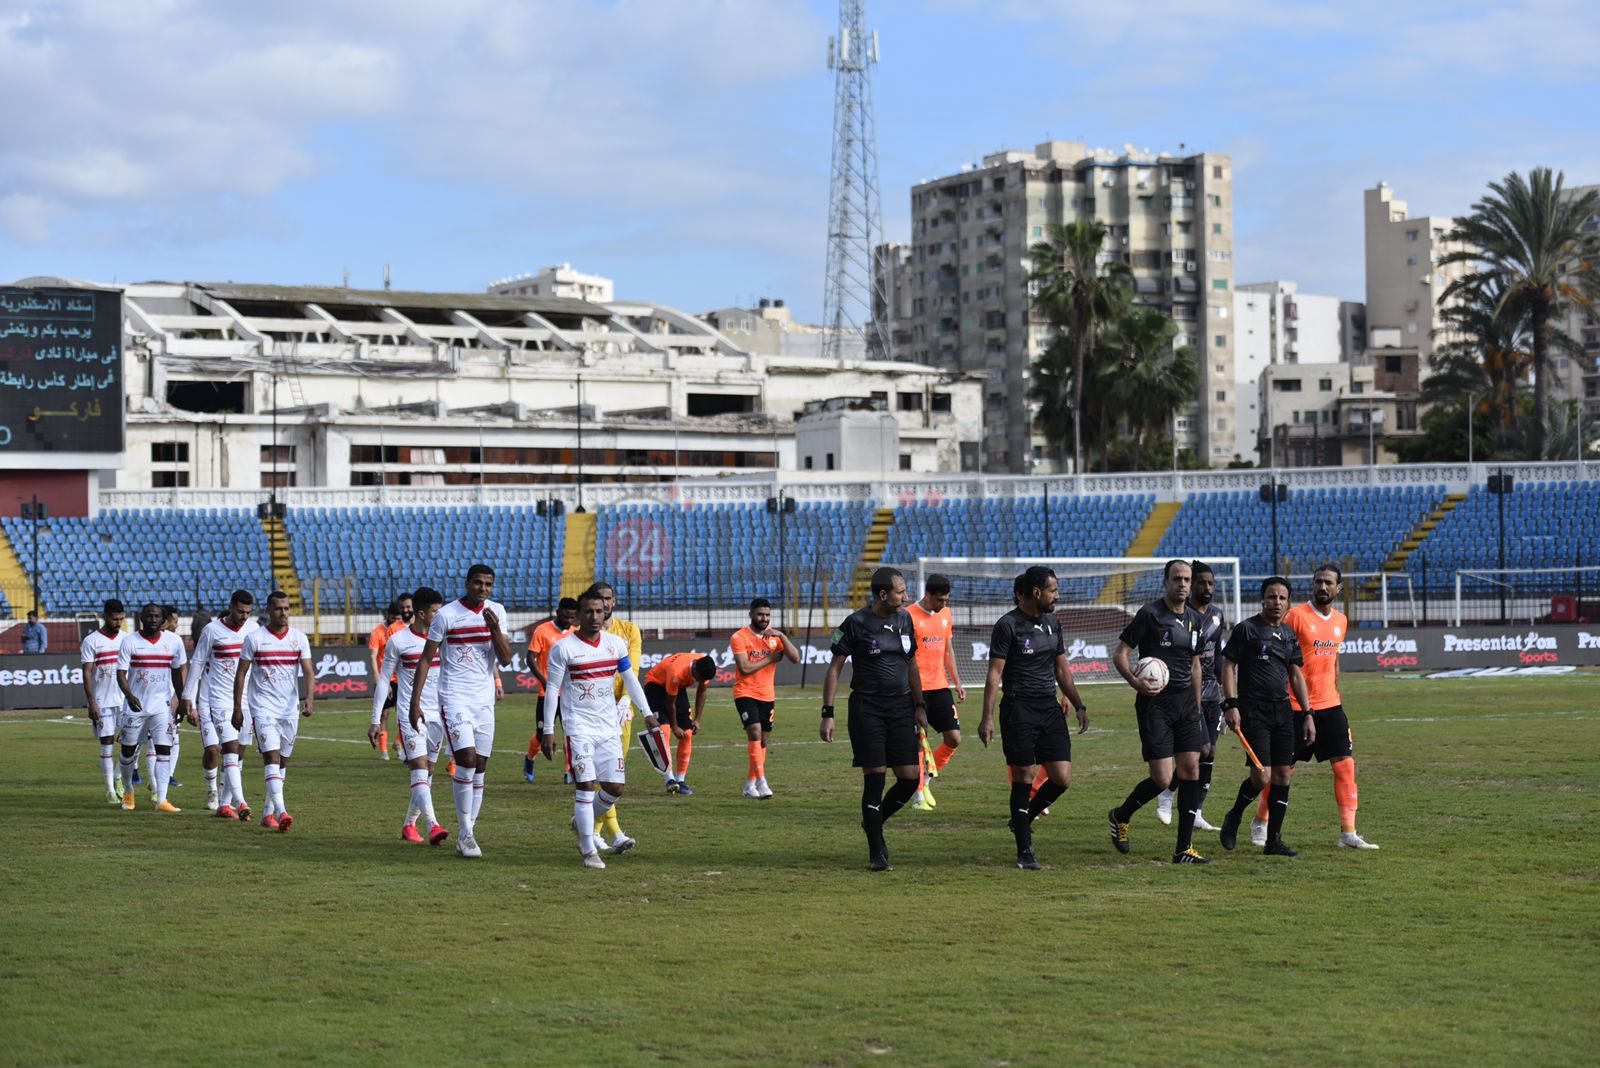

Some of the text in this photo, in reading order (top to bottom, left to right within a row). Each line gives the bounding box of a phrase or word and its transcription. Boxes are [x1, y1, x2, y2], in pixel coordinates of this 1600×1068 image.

[1338, 633, 1418, 655] entation
[1443, 631, 1558, 652] Presentation
[1376, 655, 1418, 667] Sports
[1519, 651, 1558, 664] Sports
[1069, 660, 1109, 673] ports
